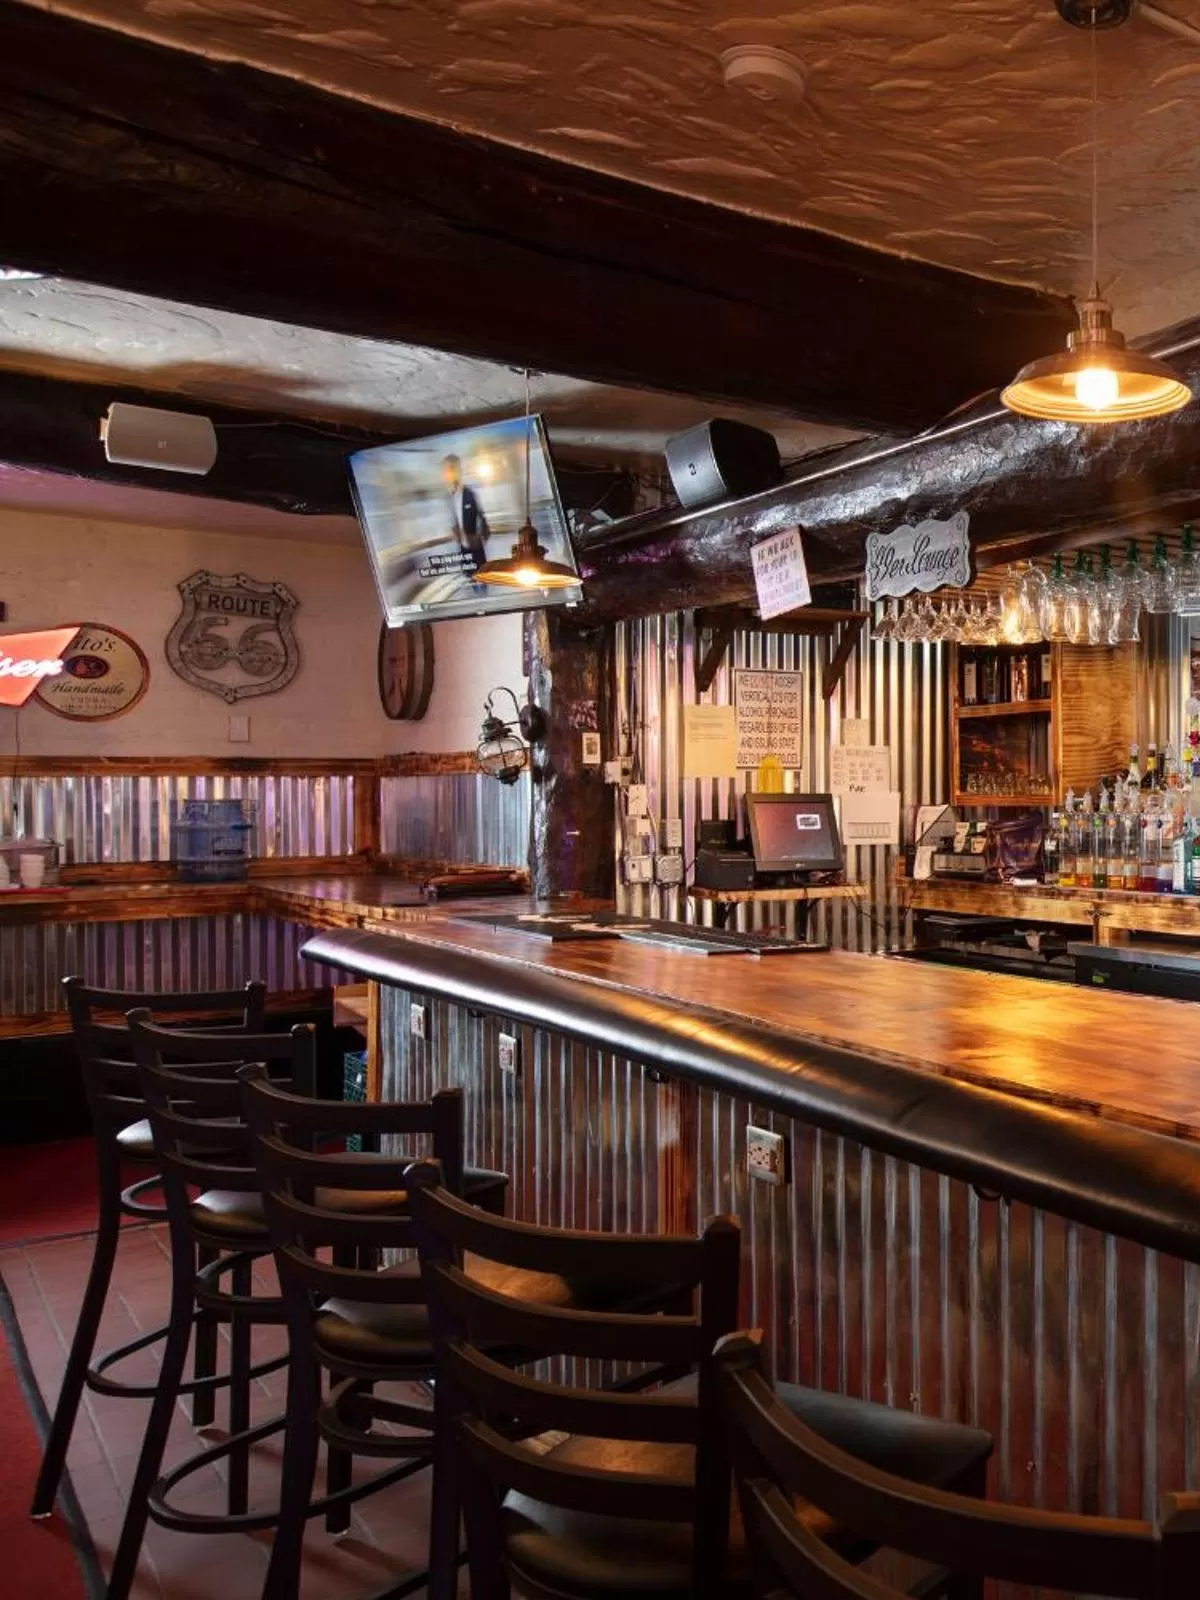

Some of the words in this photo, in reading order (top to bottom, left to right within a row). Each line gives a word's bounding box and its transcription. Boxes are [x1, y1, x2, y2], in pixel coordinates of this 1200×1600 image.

[208, 593, 271, 616] ROUTE
[180, 616, 288, 677] 66
[52, 682, 125, 695] Handmade
